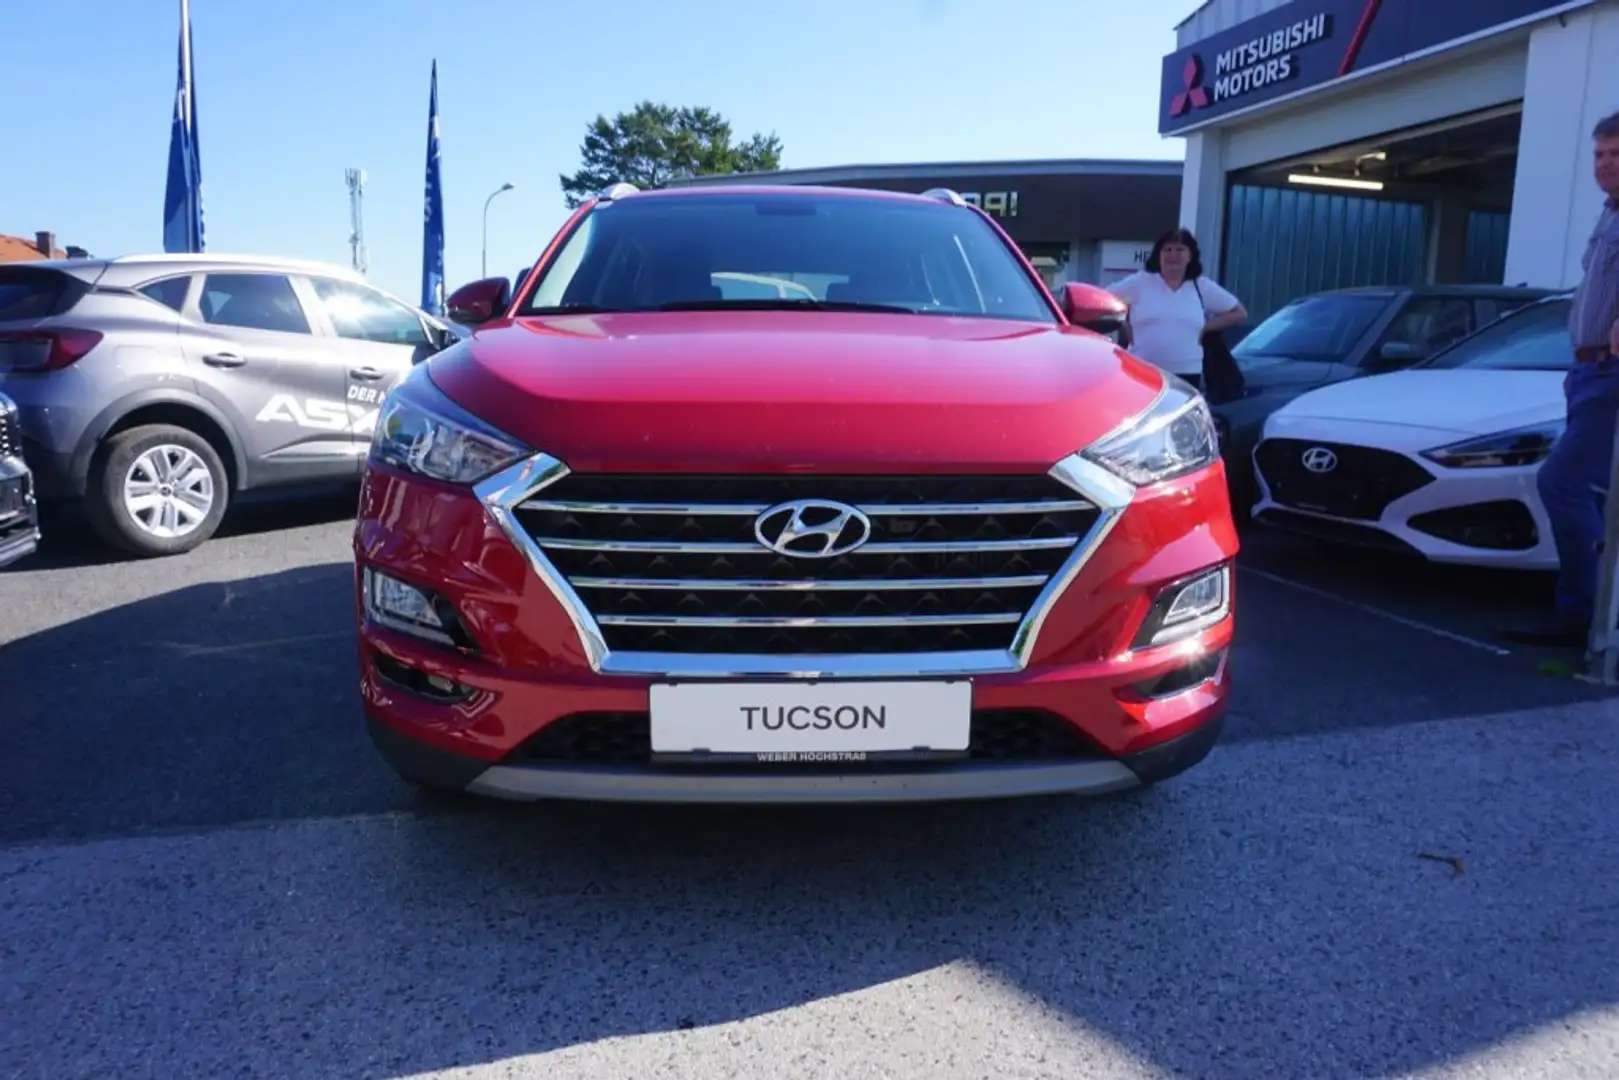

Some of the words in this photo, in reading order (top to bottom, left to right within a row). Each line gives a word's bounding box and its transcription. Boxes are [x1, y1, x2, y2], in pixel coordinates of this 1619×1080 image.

[1216, 13, 1325, 75] MITSUBISHI
[1214, 54, 1291, 101] MOTORS
[347, 385, 378, 403] DER
[740, 705, 886, 730] TUCSON
